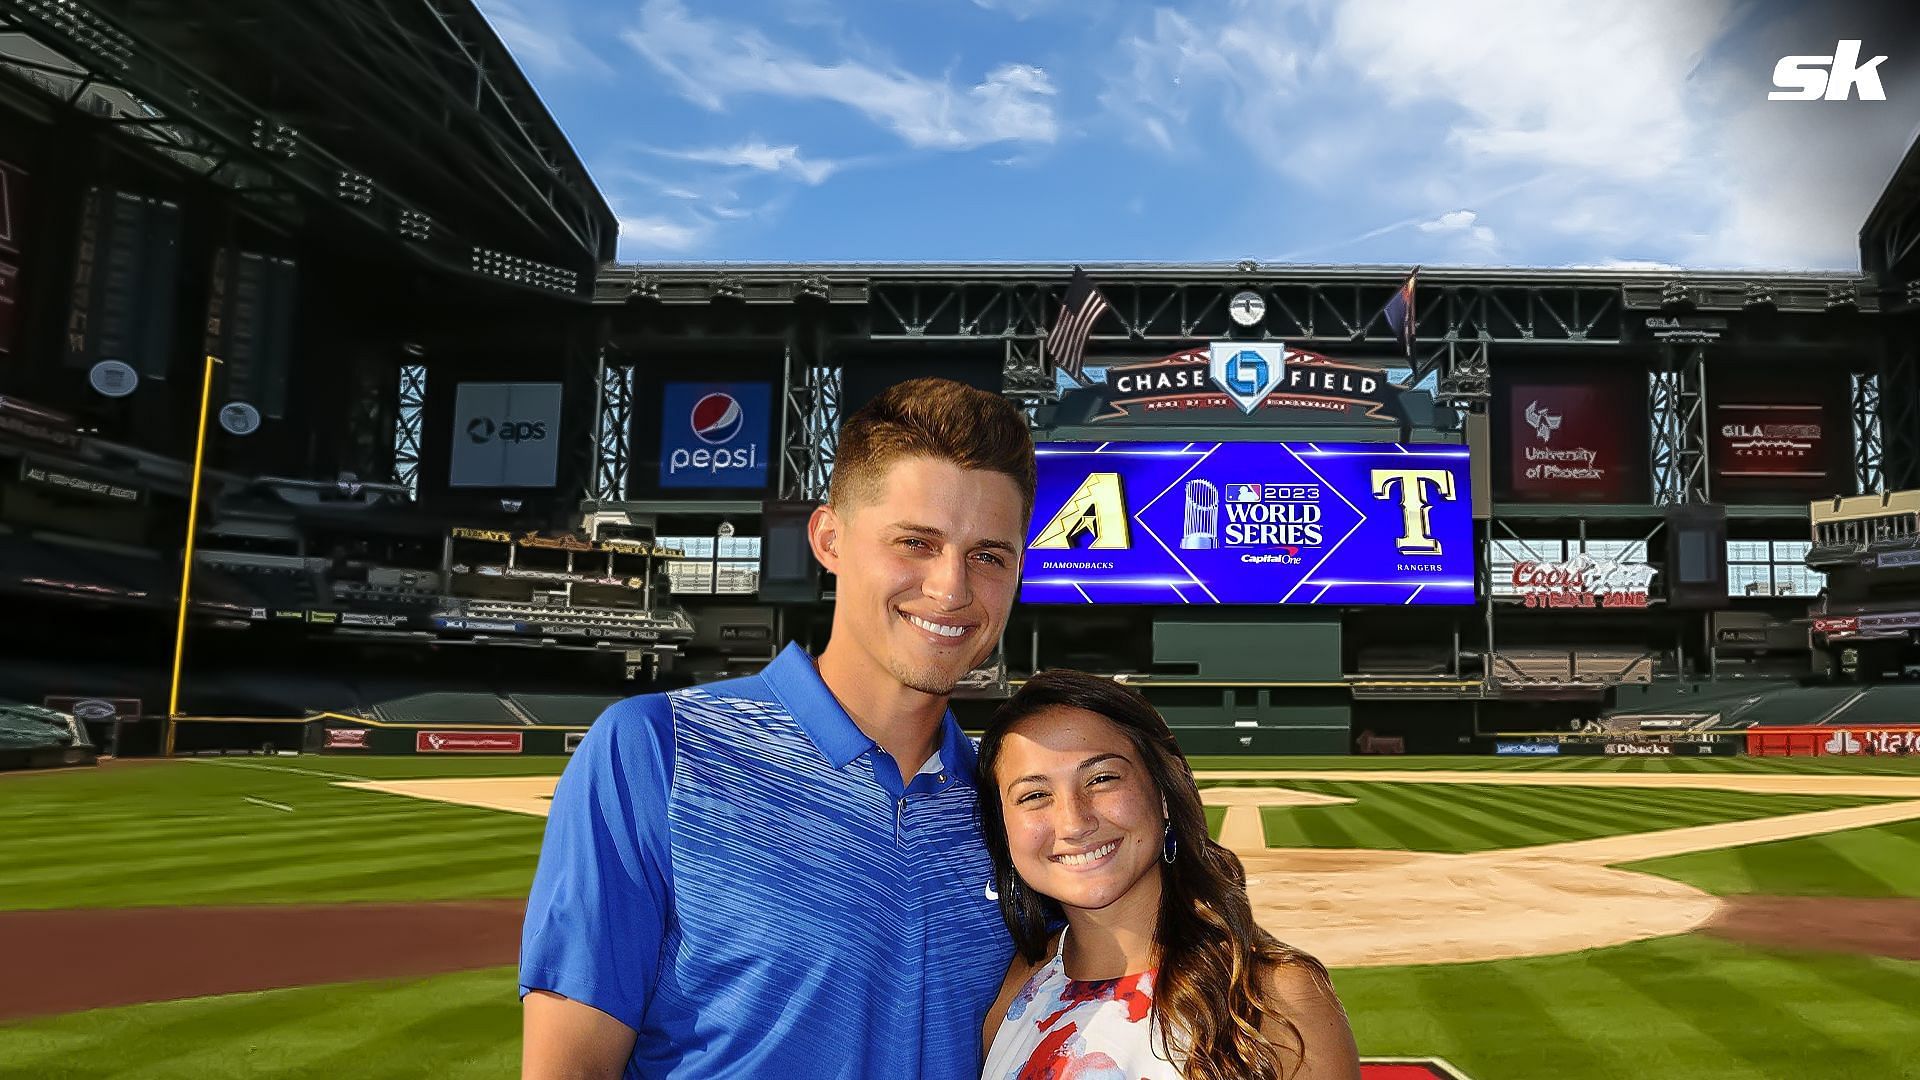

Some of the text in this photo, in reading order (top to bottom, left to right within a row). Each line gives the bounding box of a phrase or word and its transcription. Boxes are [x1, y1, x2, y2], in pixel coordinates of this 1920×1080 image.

[1117, 370, 1377, 394] CHASE FIELD
[498, 419, 547, 444] aps
[1721, 424, 1764, 438] GILA
[669, 444, 758, 474] pepsi
[1525, 464, 1541, 479] of
[1264, 487, 1320, 499] 2023
[1224, 503, 1322, 523] WORLD
[1225, 523, 1323, 545] SERIES
[1042, 561, 1114, 569] DIAMONDBACKS
[1397, 564, 1443, 572] RANGERS
[1512, 559, 1585, 588] Coors
